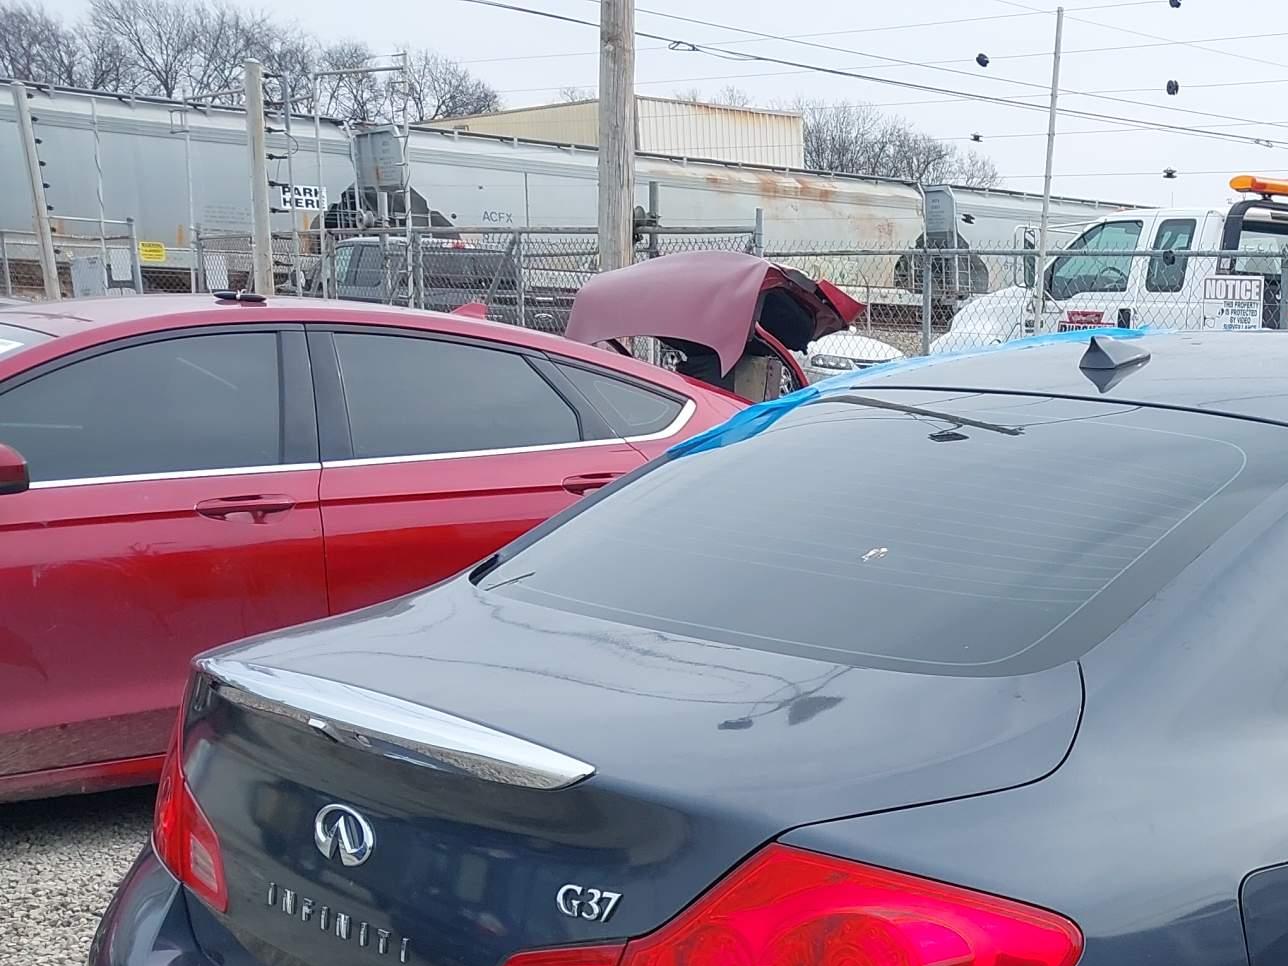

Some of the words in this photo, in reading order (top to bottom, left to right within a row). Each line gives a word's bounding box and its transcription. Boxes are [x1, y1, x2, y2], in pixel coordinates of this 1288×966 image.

[482, 211, 513, 223] ACFX
[1205, 279, 1260, 300] NOTICE
[1234, 301, 1259, 309] PROPERTY
[1230, 309, 1257, 317] PROTECTED
[1236, 316, 1251, 325] VIDEO
[556, 884, 622, 922] G37
[268, 882, 410, 963] INFINITI
